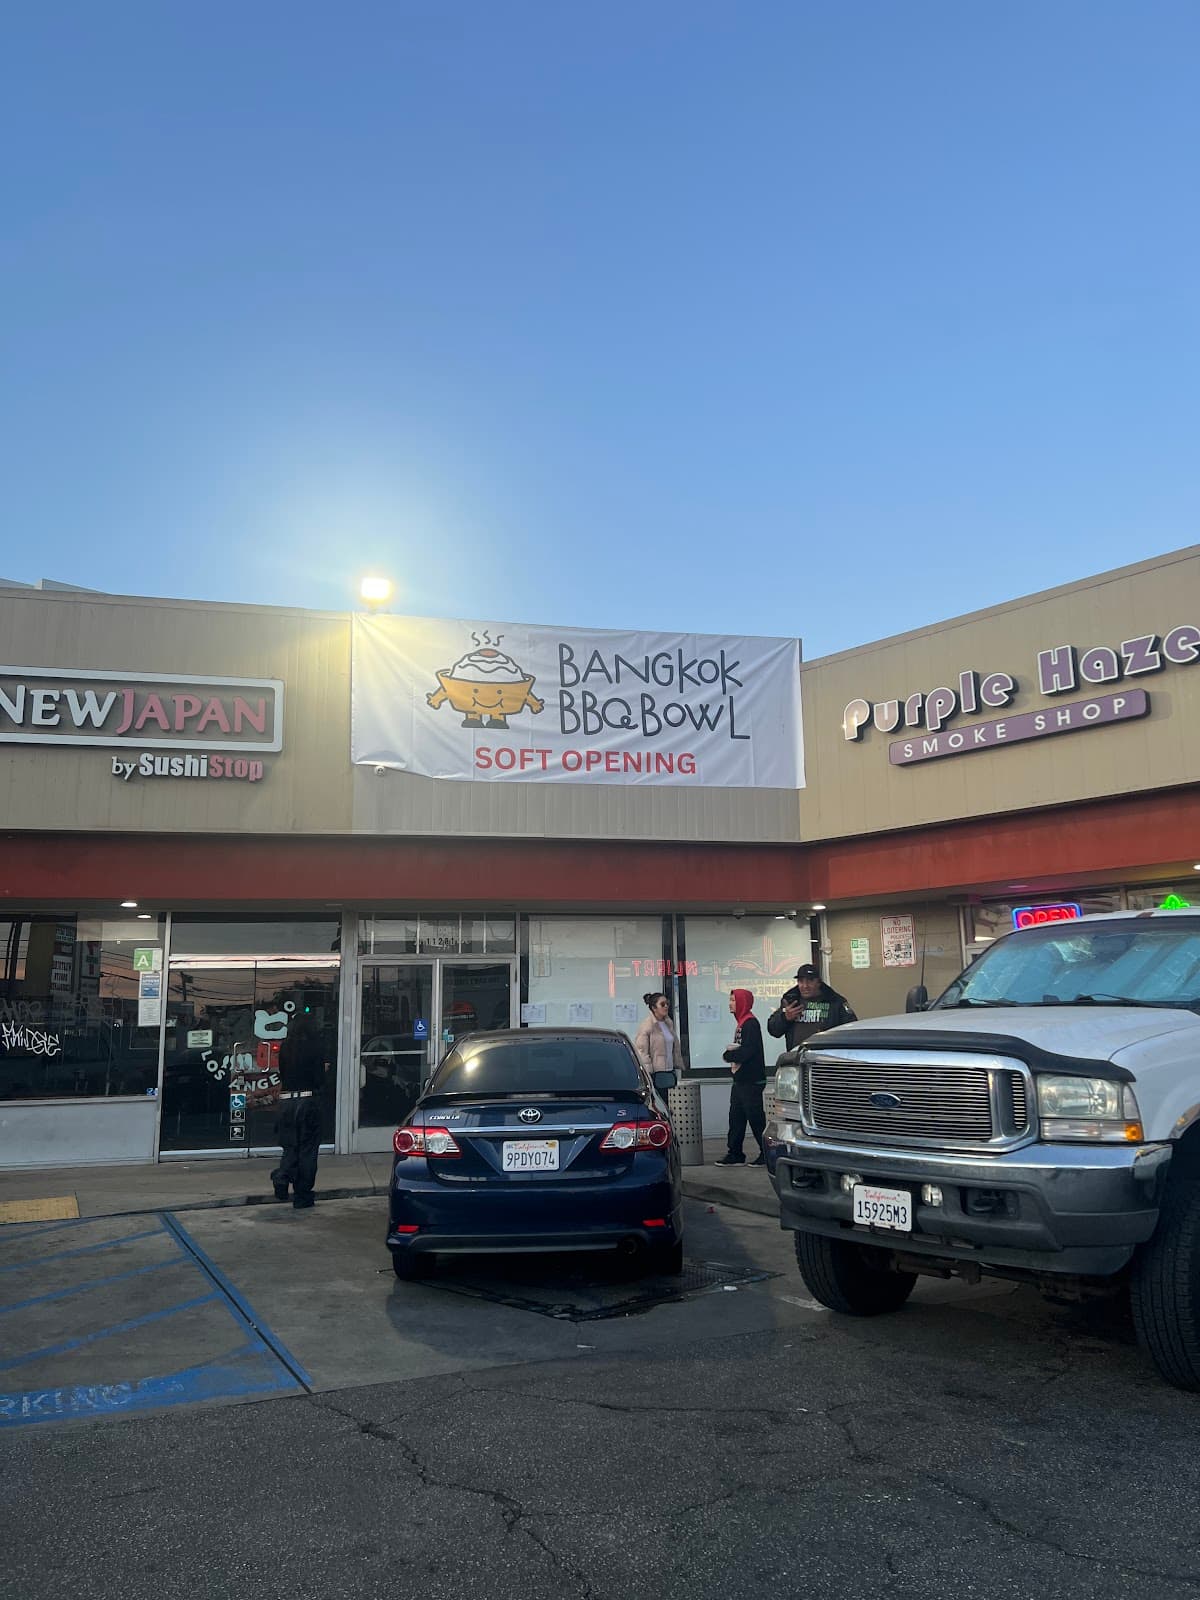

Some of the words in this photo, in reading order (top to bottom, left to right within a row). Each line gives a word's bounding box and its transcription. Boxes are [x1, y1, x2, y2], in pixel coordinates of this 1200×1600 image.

[558, 643, 743, 695] BANGKOK
[843, 671, 1014, 741] Purple
[1038, 625, 1200, 694] Haze
[558, 690, 638, 736] BBQ
[903, 724, 1007, 758] SMOKE
[1034, 697, 1126, 731] SHOP
[111, 756, 136, 781] by
[475, 746, 552, 771] SOFT
[561, 749, 697, 774] OPENING
[884, 926, 911, 934] LOITERING
[1018, 908, 1077, 928] OPEN
[137, 954, 149, 967] A
[201, 1050, 226, 1080] LOS
[228, 1073, 280, 1092] ANGE
[507, 1151, 555, 1168] 9PDY074
[857, 1200, 907, 1224] 15925M3
